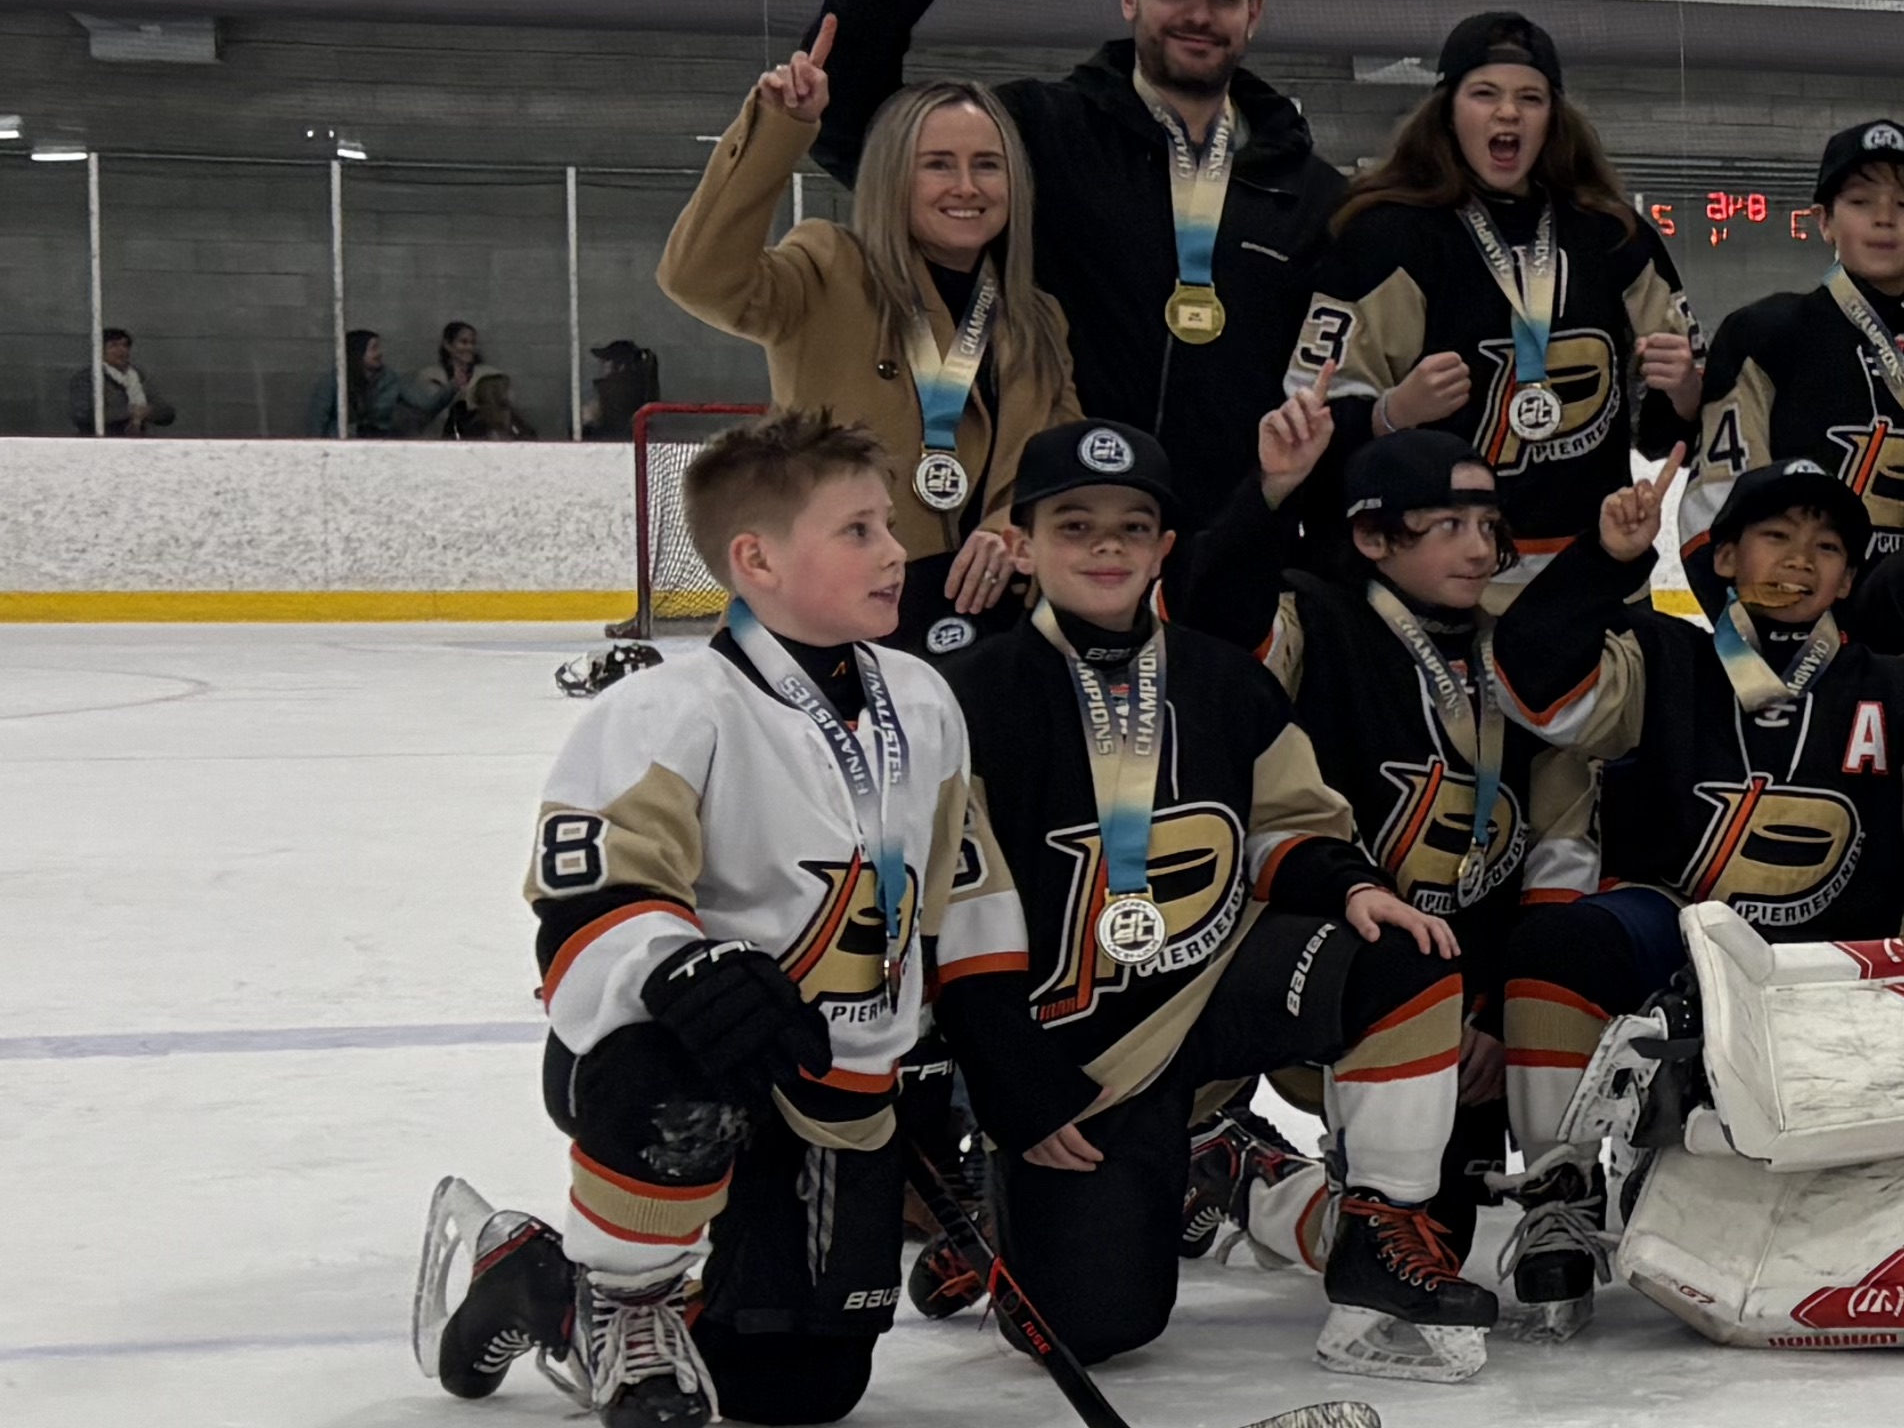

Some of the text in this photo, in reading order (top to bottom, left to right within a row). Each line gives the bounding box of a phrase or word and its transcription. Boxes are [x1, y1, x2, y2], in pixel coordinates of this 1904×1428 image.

[1300, 305, 1355, 369] 3
[1706, 407, 1748, 474] 4
[779, 673, 871, 796] FINALISTES
[1841, 699, 1892, 776] A
[537, 811, 608, 894] 8
[1285, 921, 1338, 1019] BAUER
